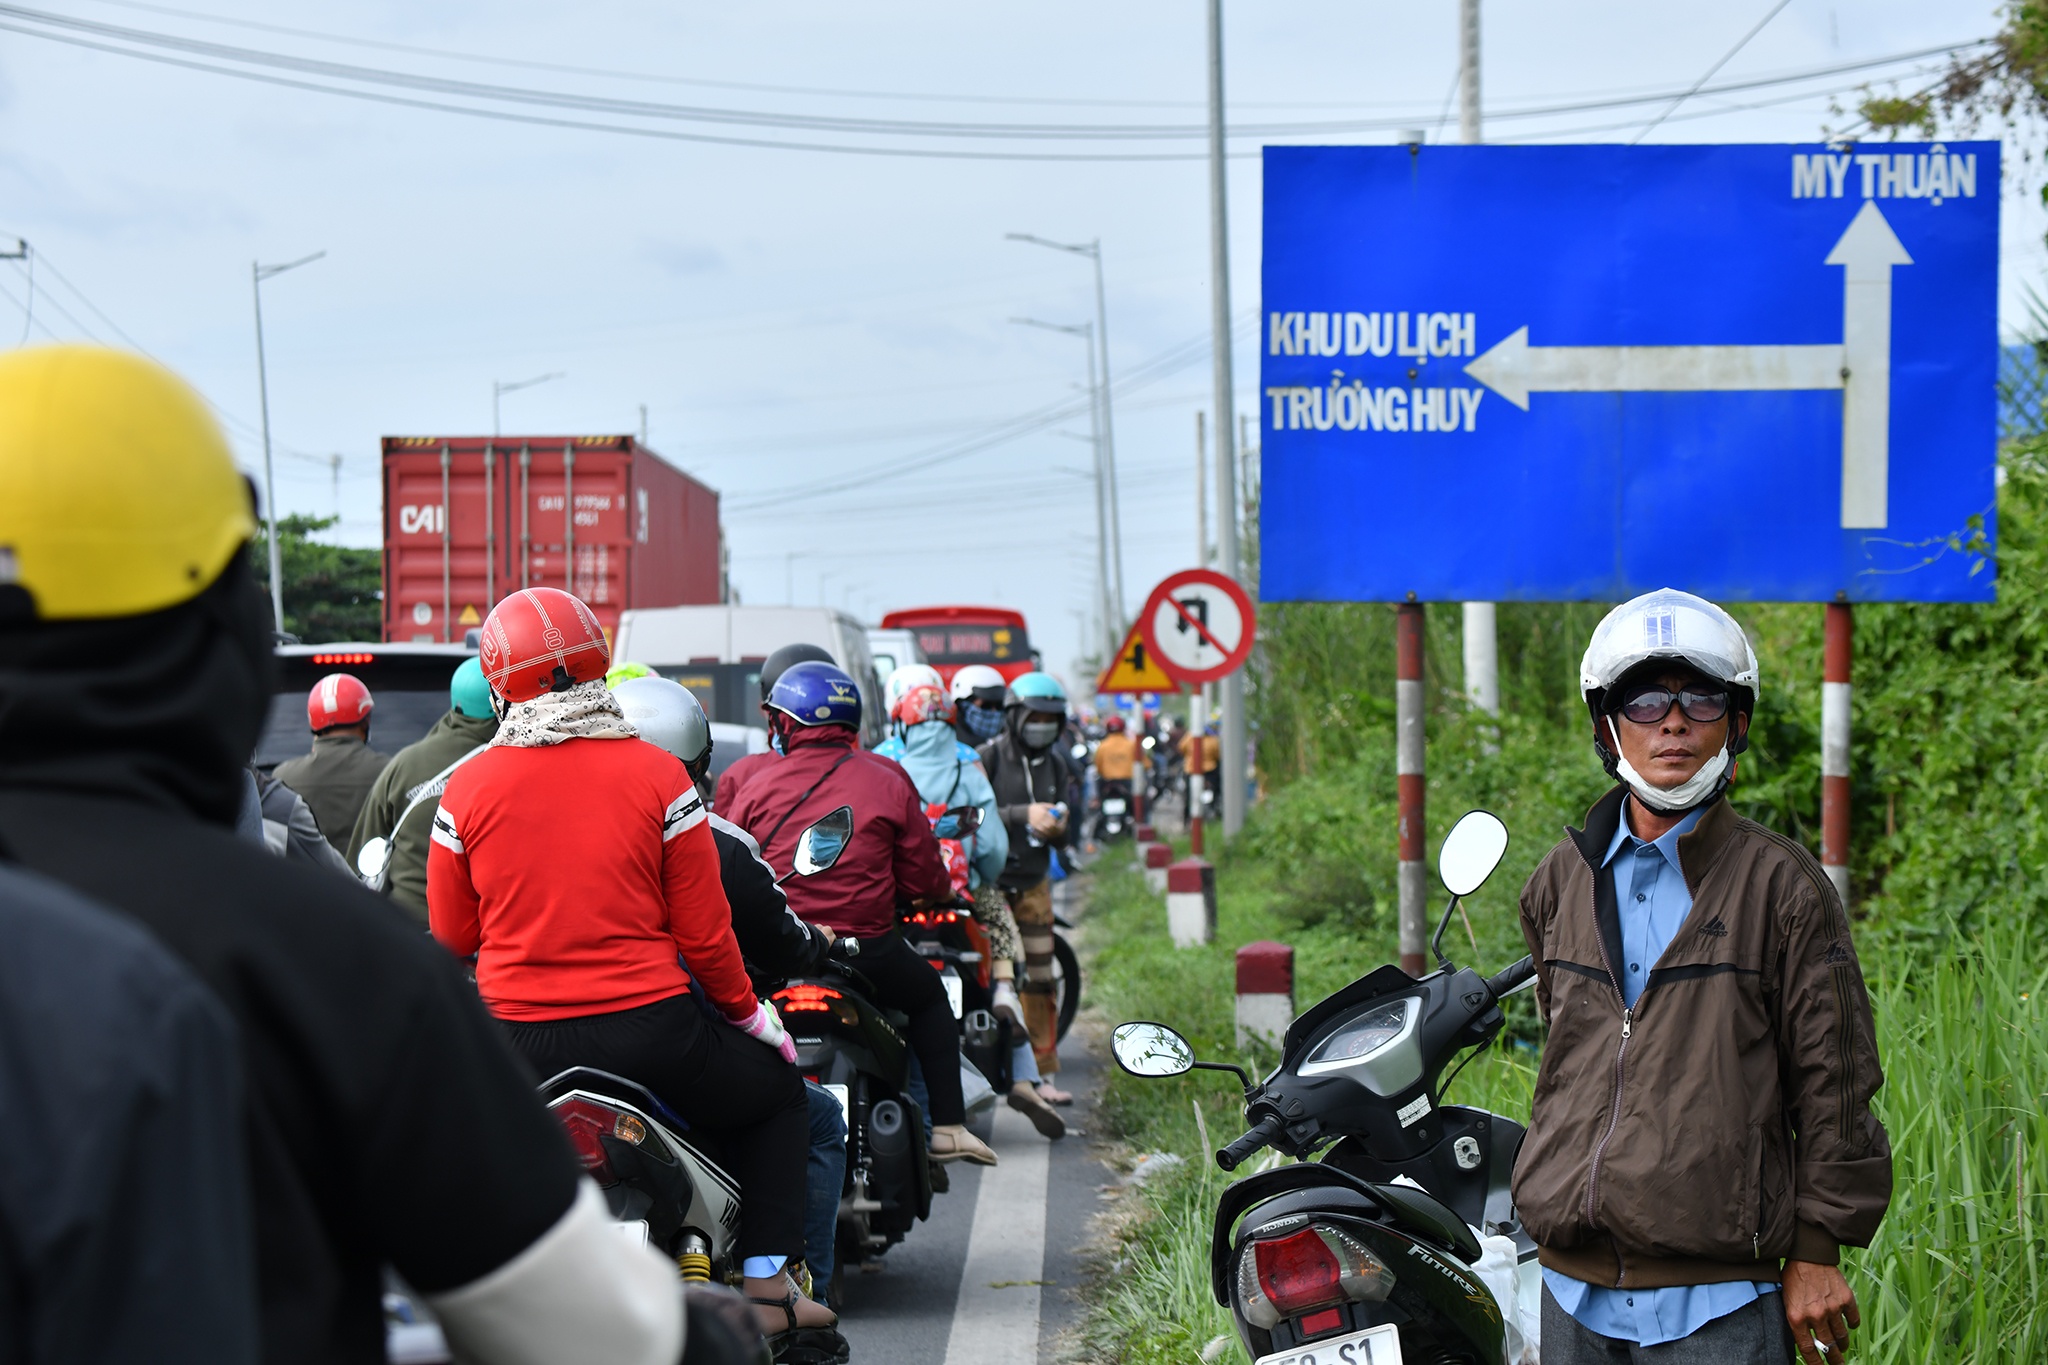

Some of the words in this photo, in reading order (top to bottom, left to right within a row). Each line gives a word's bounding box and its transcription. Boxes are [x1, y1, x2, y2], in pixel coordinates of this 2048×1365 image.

[1855, 144, 1977, 206] THUẬN
[1269, 311, 1342, 357] KHU
[1344, 311, 1395, 358] DU
[1396, 311, 1477, 366] LỊCH
[1411, 387, 1486, 432] HUY
[400, 505, 444, 534] CAI
[1262, 1216, 1300, 1233] HONDA
